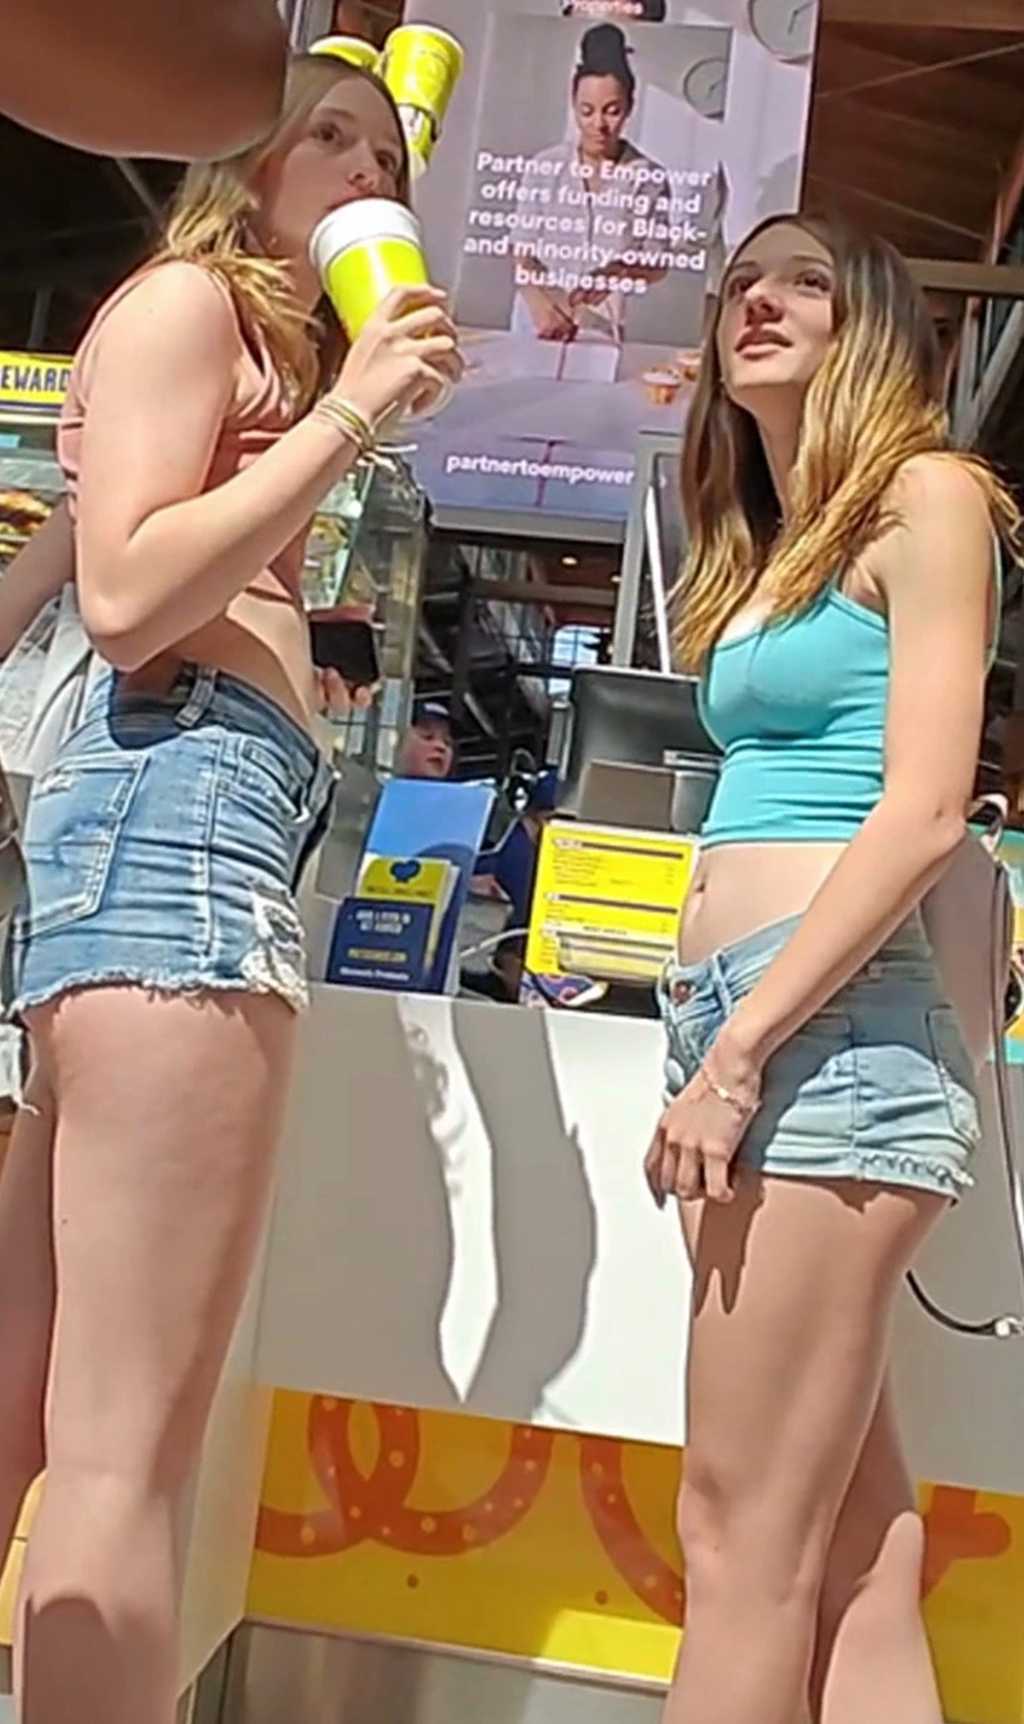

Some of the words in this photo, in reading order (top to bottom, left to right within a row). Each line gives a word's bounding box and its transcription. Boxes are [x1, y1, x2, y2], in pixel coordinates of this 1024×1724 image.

[477, 152, 563, 176] Partner
[569, 157, 594, 179] to
[601, 160, 712, 187] Empower
[481, 179, 551, 203] offers
[557, 184, 650, 214] funding
[655, 193, 701, 214] and
[468, 209, 585, 233] resources
[593, 212, 627, 236] for
[632, 217, 708, 241] Black-
[463, 235, 510, 256] and
[513, 239, 707, 271] minority-owned
[514, 263, 648, 294] businesses
[446, 454, 635, 485] partnertoempower
